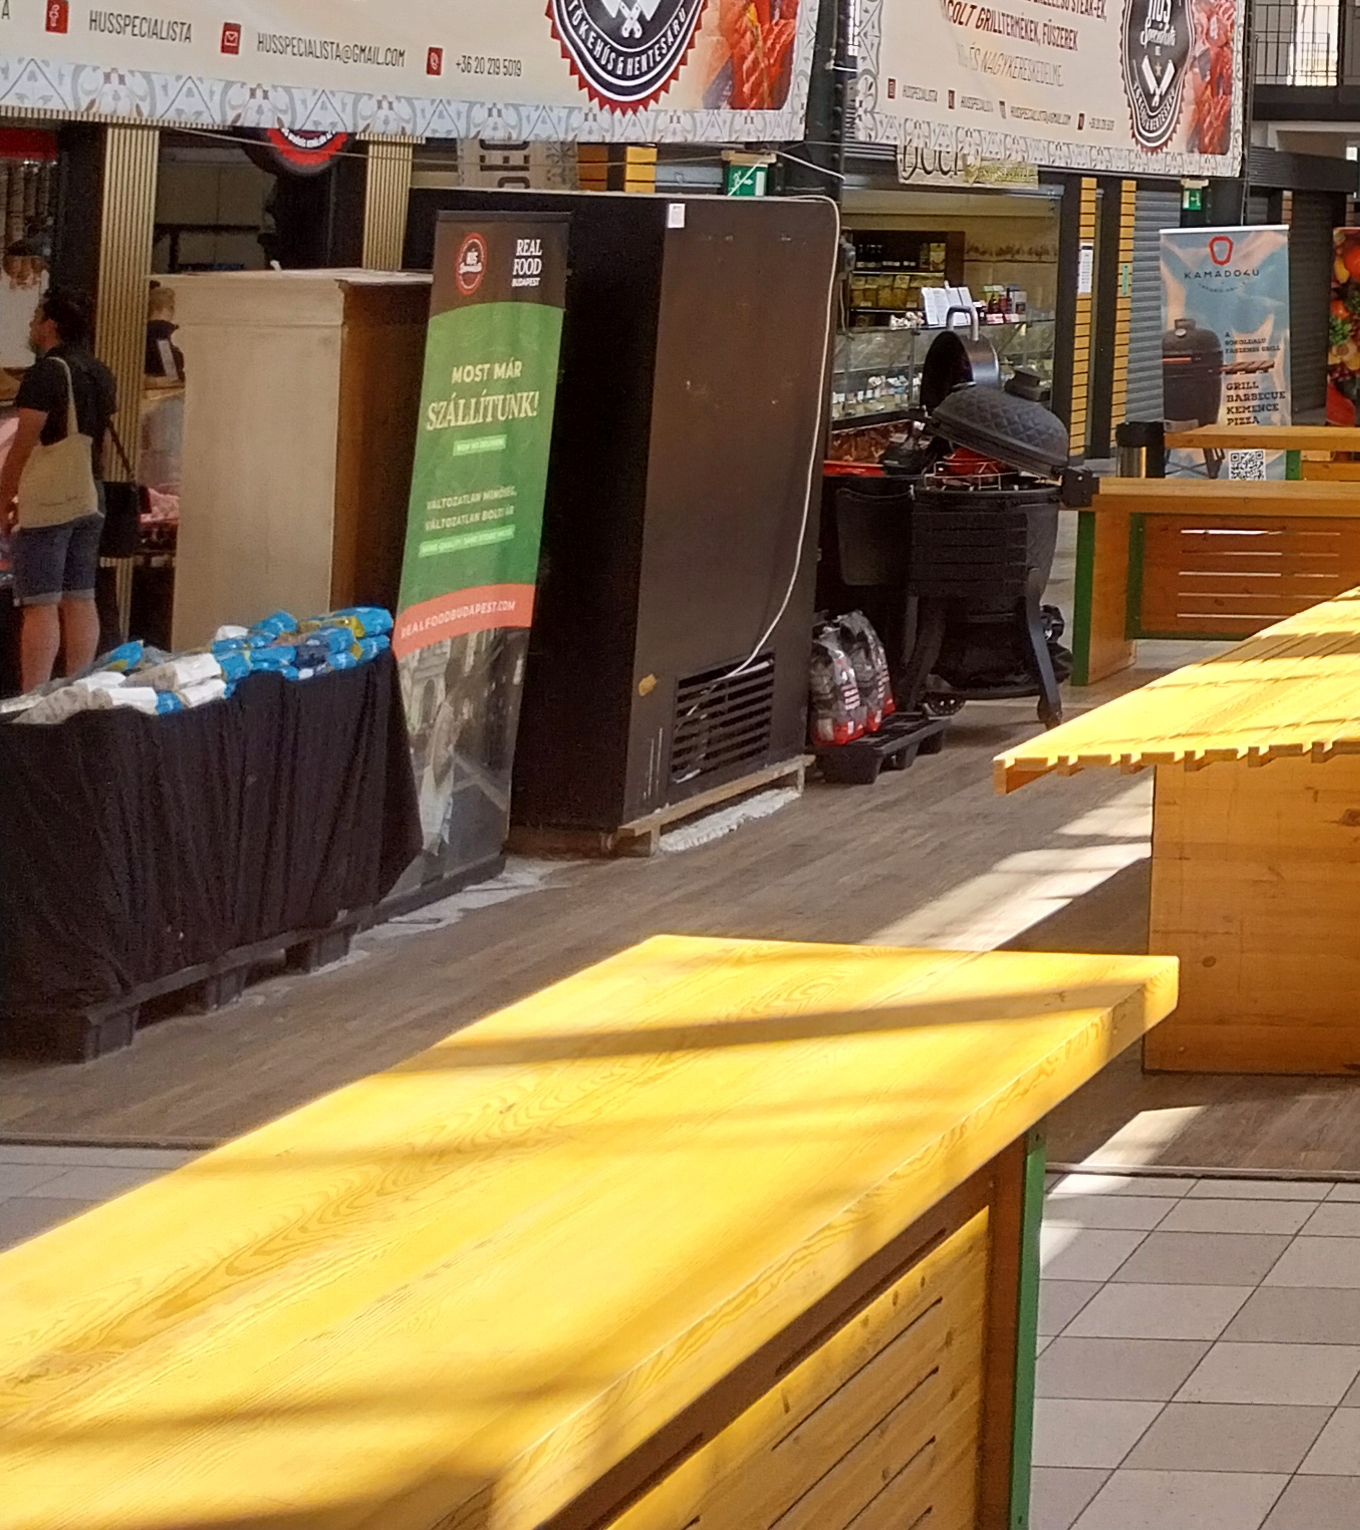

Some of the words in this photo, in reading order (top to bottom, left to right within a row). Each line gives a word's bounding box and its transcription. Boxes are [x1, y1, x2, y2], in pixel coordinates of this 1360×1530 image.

[89, 10, 192, 43] HUSSPECIALISTA
[257, 33, 405, 68] HUSSPECIALISTA@GMAIL.COM
[455, 55, 472, 74] +36
[626, 8, 687, 76] HENTESÁRU
[516, 239, 542, 256] REAL
[512, 258, 542, 275] FOOD
[451, 363, 490, 384] MOST
[493, 357, 522, 380] MÁR
[1226, 381, 1259, 391] GRILL
[1226, 391, 1286, 403] BARBECUE
[426, 388, 540, 430] SZÁLLÍTUNK!
[1226, 404, 1279, 415] KEMENCE
[1227, 416, 1260, 426] PIZZA
[400, 600, 515, 639] REALFOODBUDAPEST.COM
